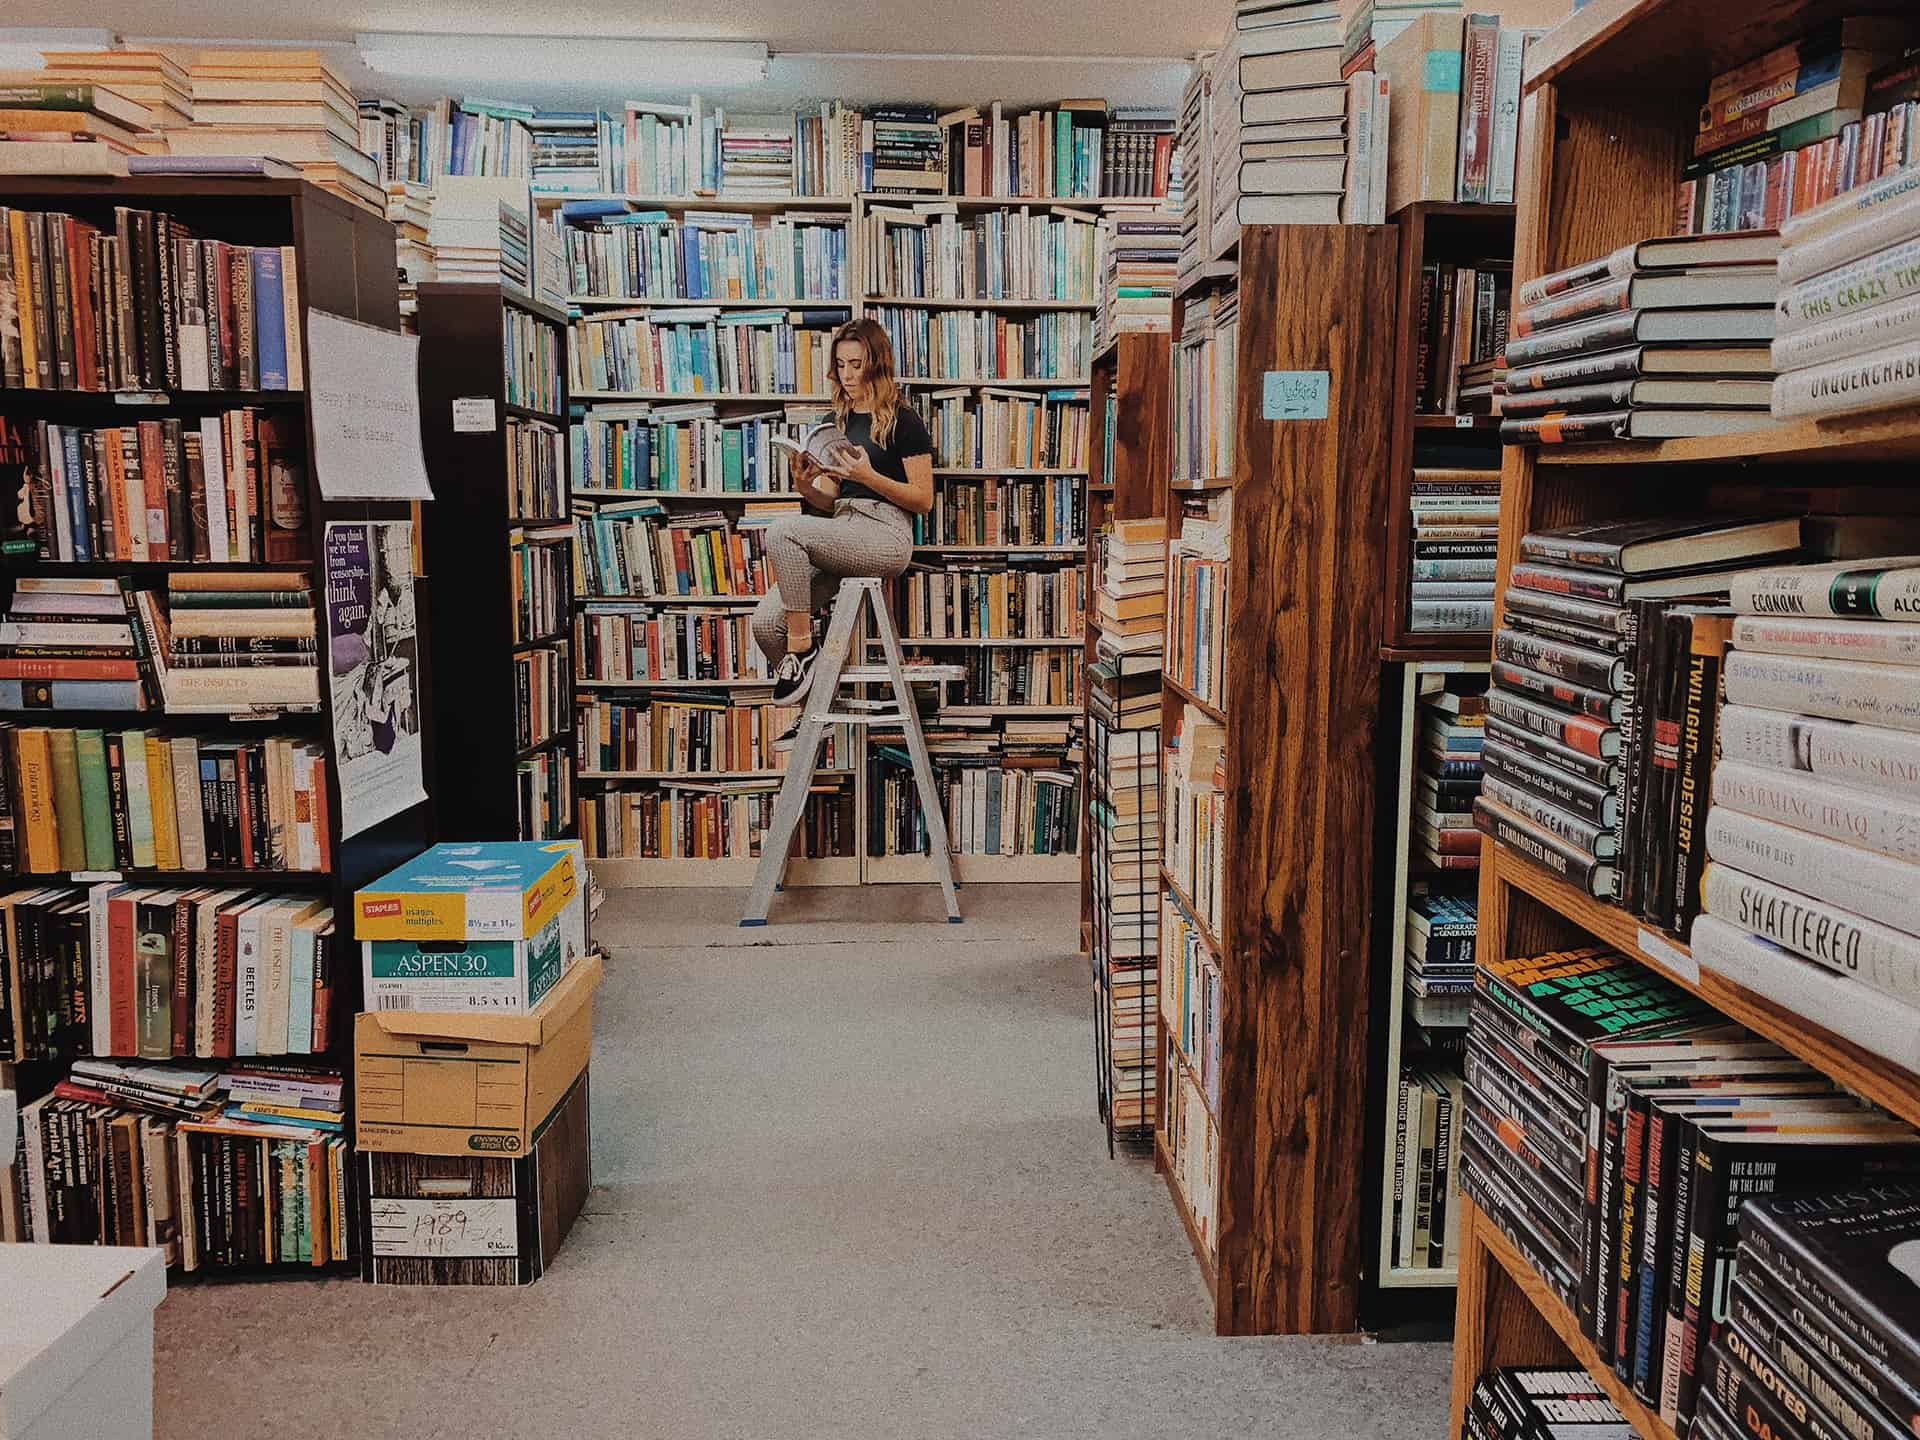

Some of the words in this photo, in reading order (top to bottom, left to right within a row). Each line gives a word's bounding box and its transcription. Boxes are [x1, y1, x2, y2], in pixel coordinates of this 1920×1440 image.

[1473, 38, 1485, 74] JEWISH
[1471, 75, 1483, 115] CULTURE
[159, 235, 168, 280] BLACKSTONE
[205, 256, 216, 284] DANCE
[161, 280, 169, 301] BOOK
[208, 284, 217, 320] JAMAICA
[1801, 297, 1832, 320] THIS
[1837, 278, 1888, 308] CRAZY
[163, 301, 170, 313] OF
[164, 314, 172, 336] MAGIC
[166, 343, 174, 374] ILLUSION
[210, 336, 220, 384] NETTLEFORD
[85, 460, 94, 481] LEARN
[111, 449, 120, 480] FRANK
[87, 482, 96, 507] MAGIC
[328, 545, 346, 554] we're
[347, 541, 360, 553] free
[329, 529, 334, 542] If
[335, 533, 347, 546] you
[347, 528, 363, 541] think
[1439, 544, 1449, 554] THE
[1450, 543, 1483, 554] POLICEMAN
[330, 555, 346, 567] from
[329, 579, 358, 604] think
[1751, 594, 1807, 614] ECONOMY
[338, 605, 368, 629] again.
[144, 621, 160, 657] IGUANAS
[1732, 664, 1766, 680] SIMON
[1771, 668, 1824, 687] SCHAMA
[1686, 658, 1704, 754] TWILIGHT
[1635, 706, 1643, 751] DYING
[1618, 744, 1628, 769] THE
[1633, 759, 1640, 777] TO
[1819, 747, 1846, 768] RON
[1851, 751, 1920, 783] SUSKIND
[112, 772, 121, 791] BUGS
[1503, 760, 1514, 772] Does
[1540, 778, 1556, 797] Really
[1555, 787, 1573, 801] Work?
[1616, 772, 1627, 814] DESERT
[1632, 786, 1640, 814] WIN
[1721, 779, 1814, 820] DISARMING
[1822, 806, 1871, 841] IRAQ
[115, 810, 126, 841] SYSTEM
[1678, 778, 1695, 854] DESERT
[1498, 822, 1543, 860] STANDARDIZED
[1544, 849, 1567, 874] MINDS
[1615, 815, 1625, 854] MYSTIC
[1744, 838, 1771, 857] NEVER
[1774, 848, 1795, 866] DIES
[365, 903, 399, 914] STAPLES
[406, 918, 443, 926] multiples
[180, 905, 189, 943] AFRICAN
[273, 927, 283, 943] THE
[1740, 886, 1862, 971] SHATTERED
[220, 924, 232, 964] Insects
[315, 939, 324, 977] MOSQUITO
[179, 944, 187, 977] INSECT
[220, 966, 230, 979] in
[271, 947, 282, 991] INSECTS
[397, 956, 457, 972] ASPEN
[462, 955, 487, 972] 30
[152, 984, 160, 1012] Insects
[178, 978, 187, 998] LIFE
[245, 967, 255, 1011] BEETLES
[469, 996, 487, 1006] 8.5
[504, 996, 516, 1006] 11
[1430, 983, 1450, 993] ABBA
[1450, 983, 1472, 993] EBAN
[1528, 983, 1560, 997] A
[1560, 989, 1596, 1005] at
[74, 990, 86, 1024] ANTS
[217, 981, 231, 1042] Perspective
[48, 1113, 60, 1153] Martial
[222, 1139, 230, 1152] THE
[1465, 1114, 1501, 1153] PANDORA'S
[1604, 1137, 1614, 1154] In
[1648, 1115, 1664, 1188] TERRORISM
[1680, 1147, 1690, 1172] OUR
[51, 1154, 63, 1182] Arts
[223, 1172, 231, 1184] THE
[1731, 1162, 1746, 1175] LIFE
[1747, 1163, 1753, 1175] &
[1754, 1162, 1776, 1175] DEATH
[1602, 1159, 1613, 1219] Defense
[1624, 1182, 1635, 1203] How
[1729, 1179, 1738, 1192] IN
[1740, 1179, 1753, 1192] THE
[1755, 1179, 1774, 1192] LAND
[1622, 1203, 1634, 1221] The
[1675, 1175, 1689, 1242] POSTHUMAN
[1728, 1196, 1737, 1209] OF
[413, 1210, 467, 1240] 1989
[1600, 1219, 1610, 1241] of
[1621, 1223, 1632, 1245] West
[1643, 1197, 1658, 1270] DEMOCRACY
[1797, 1218, 1825, 1228] The
[1828, 1215, 1856, 1225] War
[1859, 1212, 1879, 1221] for
[1672, 1245, 1684, 1289] FUTURE
[1686, 1232, 1705, 1306] UNINSURED
[1596, 1242, 1610, 1336] Globalization
[1778, 1253, 1793, 1273] The
[1795, 1267, 1811, 1289] War
[1812, 1280, 1827, 1299] for
[1827, 1293, 1860, 1331] Muslim
[1861, 1324, 1889, 1357] Minds
[1792, 1307, 1830, 1351] Closed
[1831, 1345, 1880, 1399] Borders
[1663, 1333, 1681, 1412] FUKUYAMA
[1749, 1352, 1807, 1424] NOTES
[1476, 1382, 1491, 1408] JAMES
[1490, 1405, 1507, 1430] LAXER
